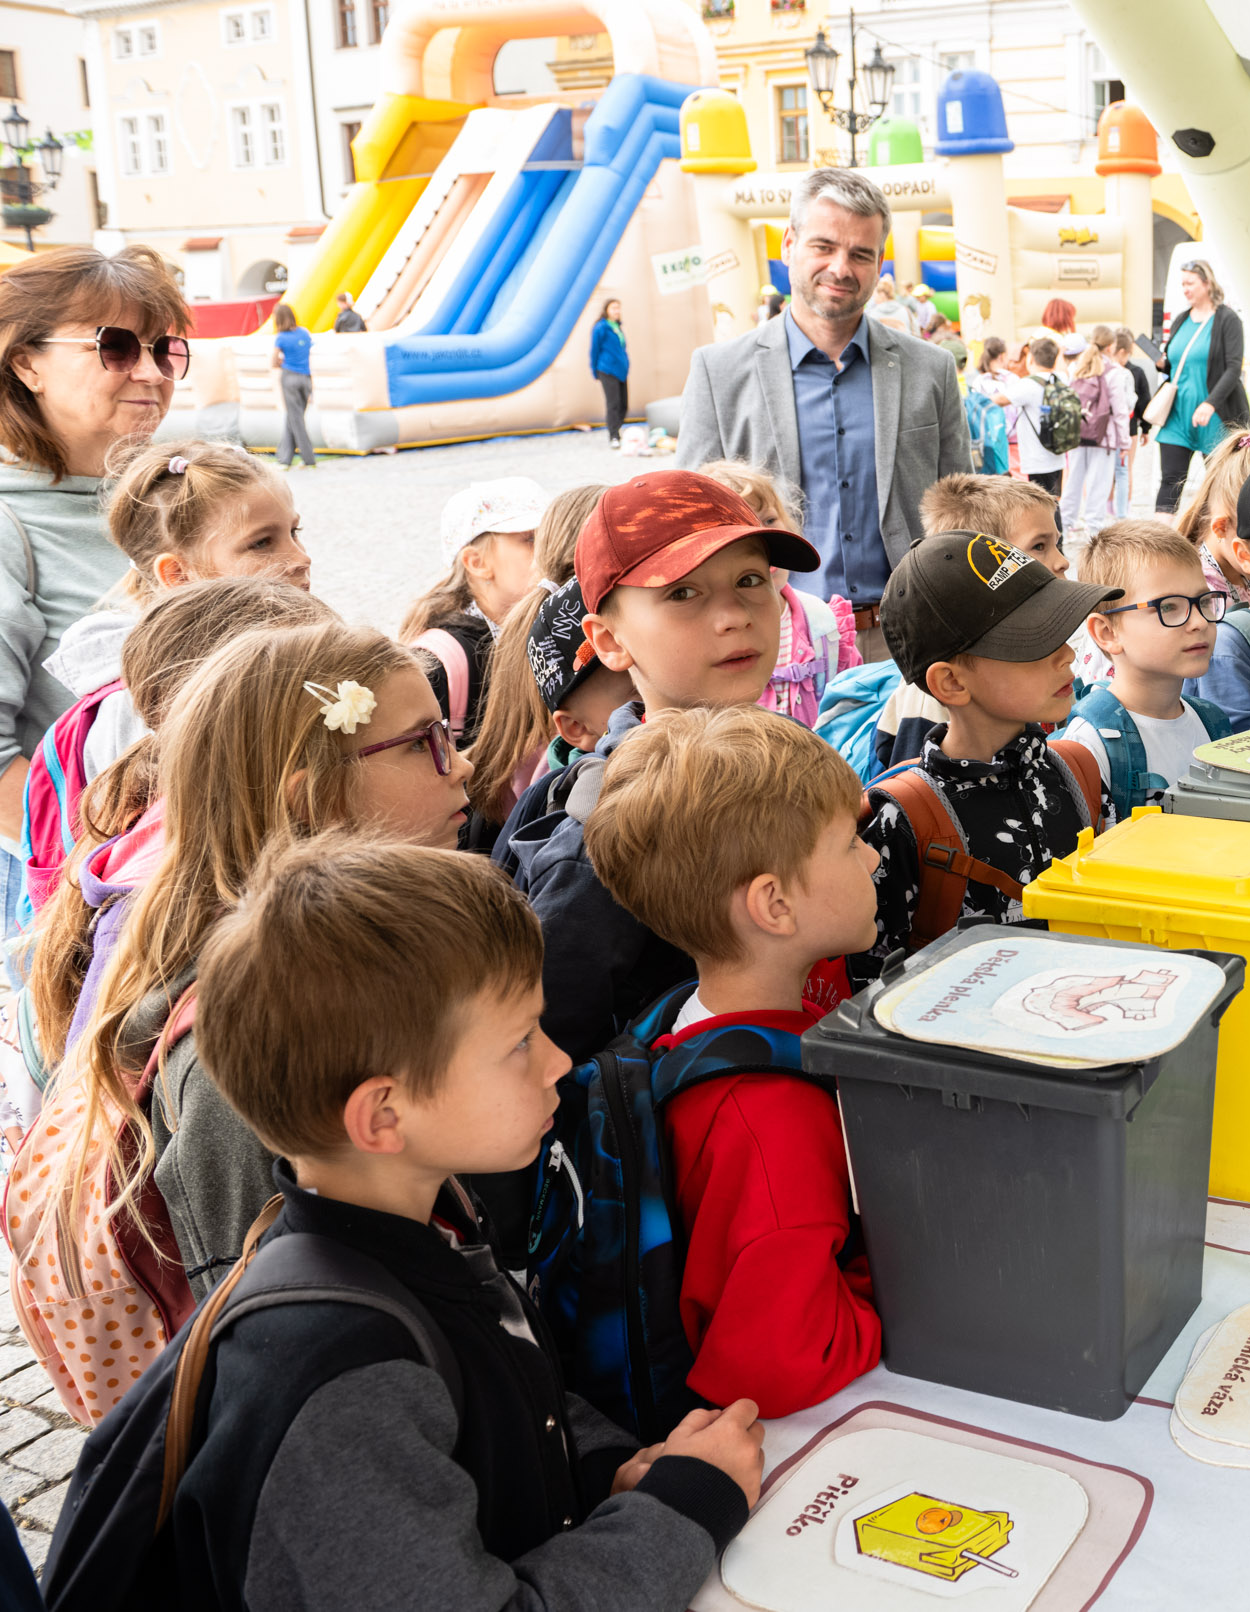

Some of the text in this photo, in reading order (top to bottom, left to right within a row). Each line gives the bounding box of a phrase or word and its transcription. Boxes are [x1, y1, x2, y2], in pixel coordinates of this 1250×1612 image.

[883, 179, 936, 197] ODPAD!
[989, 566, 1010, 589] RAMP
[917, 949, 1019, 1022] Dětská plenka
[536, 1178, 551, 1221] BECKMANN
[1201, 1383, 1234, 1416] váza
[785, 1473, 860, 1537] Pitíčko
